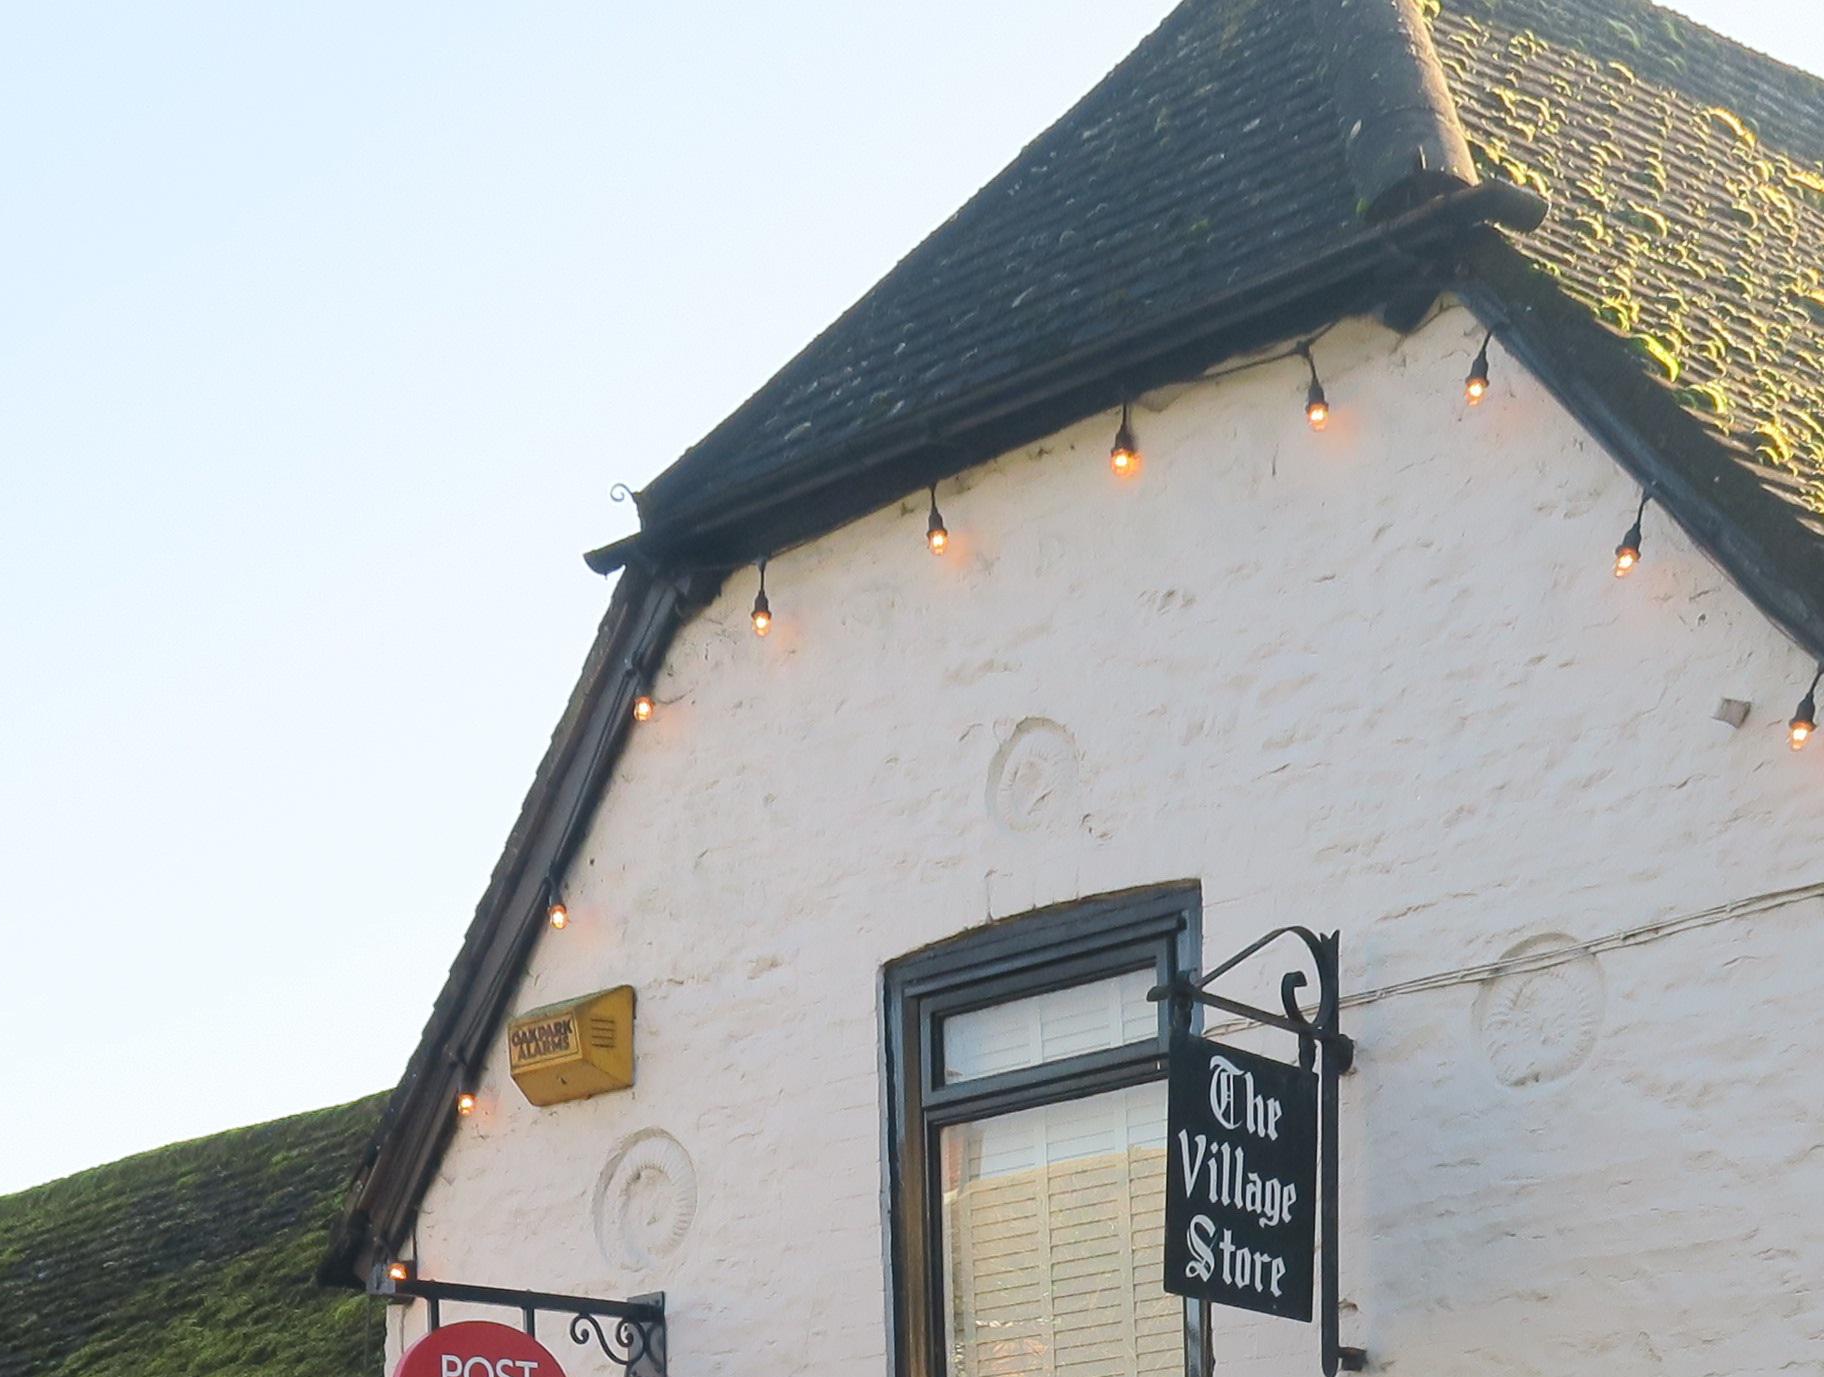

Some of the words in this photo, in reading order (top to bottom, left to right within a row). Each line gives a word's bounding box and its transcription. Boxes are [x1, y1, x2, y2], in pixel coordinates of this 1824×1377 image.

[518, 1034, 569, 1060] ALARMS
[1209, 1054, 1283, 1141] The
[1178, 1128, 1297, 1229] Village
[1185, 1214, 1287, 1298] Store
